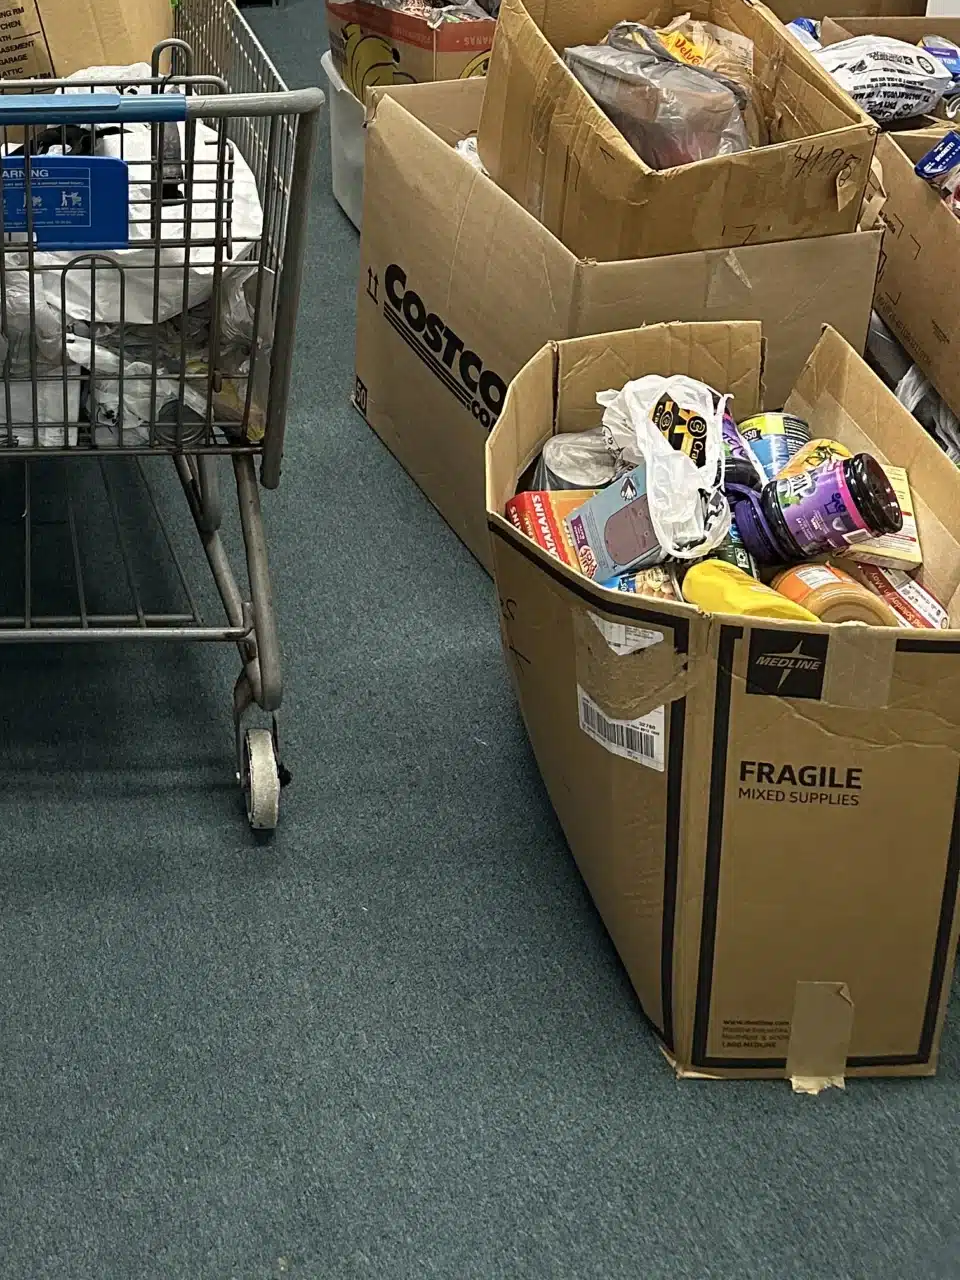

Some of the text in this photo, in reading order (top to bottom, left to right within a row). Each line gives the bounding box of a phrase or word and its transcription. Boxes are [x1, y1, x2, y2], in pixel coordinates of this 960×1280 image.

[13, 6, 25, 15] RM
[675, 38, 701, 65] Velve
[2, 67, 24, 78] ATTIC
[384, 263, 508, 416] COSTCO
[531, 494, 560, 561] ATARAINS
[756, 656, 822, 671] MEDLINE
[740, 760, 863, 790] FRAGILE
[738, 787, 860, 806] MIXED SUPPLIES
